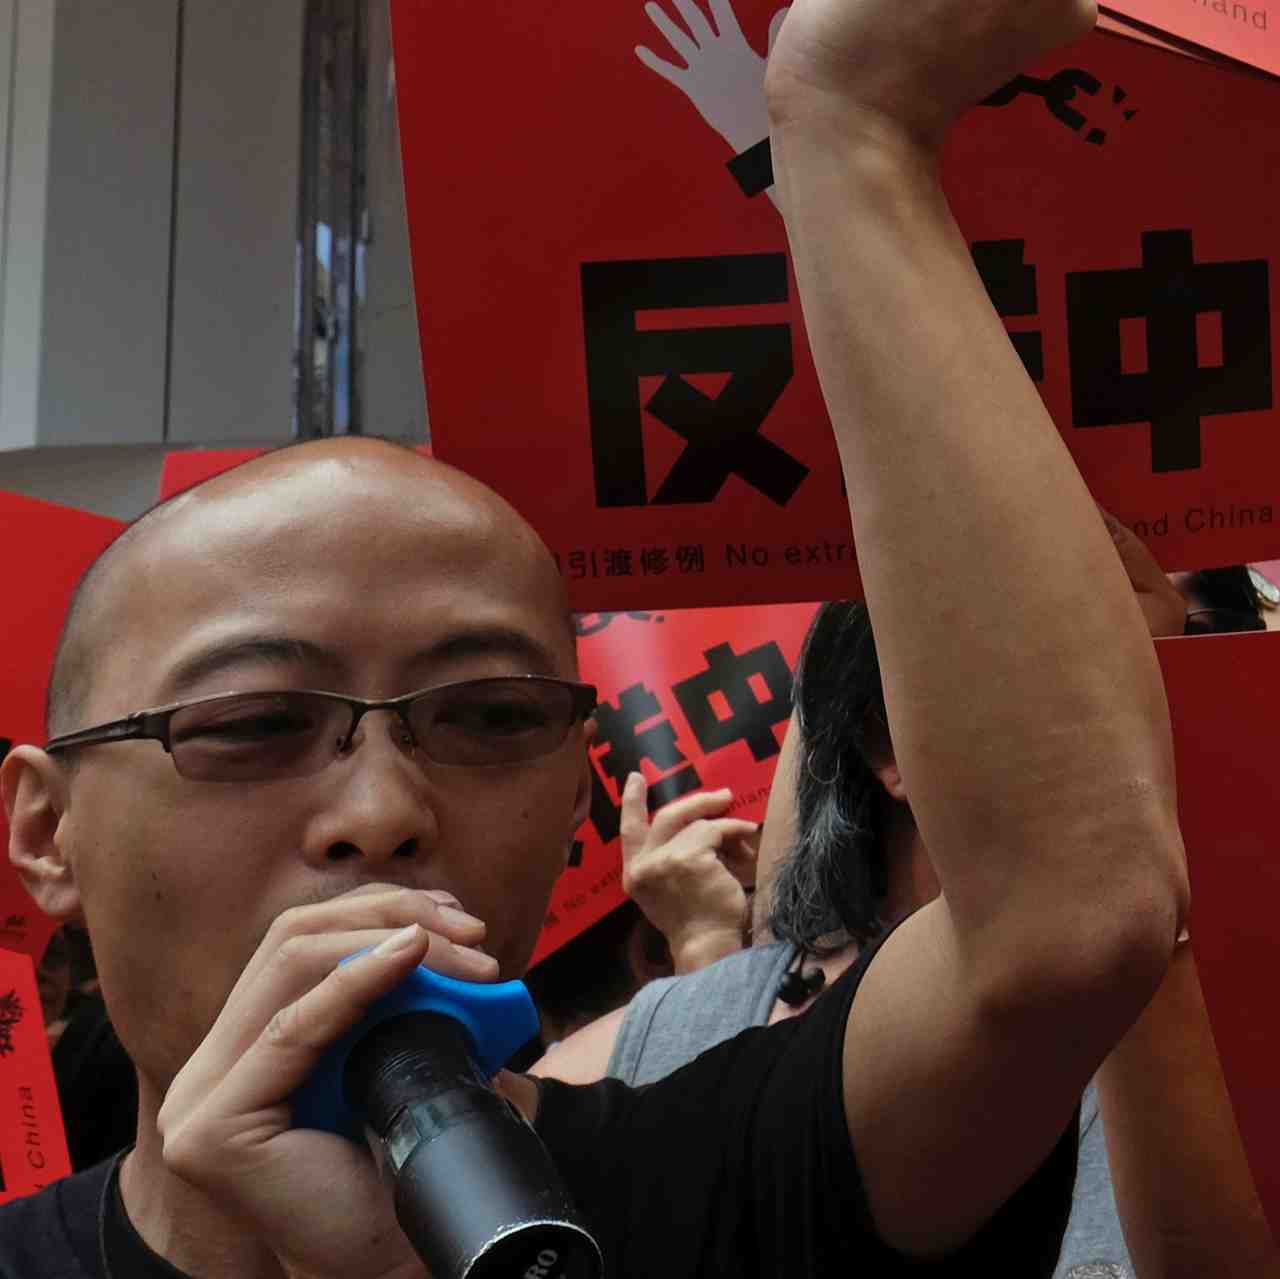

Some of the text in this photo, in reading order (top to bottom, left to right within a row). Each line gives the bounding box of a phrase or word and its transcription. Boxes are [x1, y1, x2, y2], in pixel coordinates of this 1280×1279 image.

[580, 228, 1273, 509] 反中
[1184, 503, 1274, 535] China
[554, 542, 705, 580] 引渡修例
[723, 542, 769, 568] No
[26, 1085, 47, 1173] China
